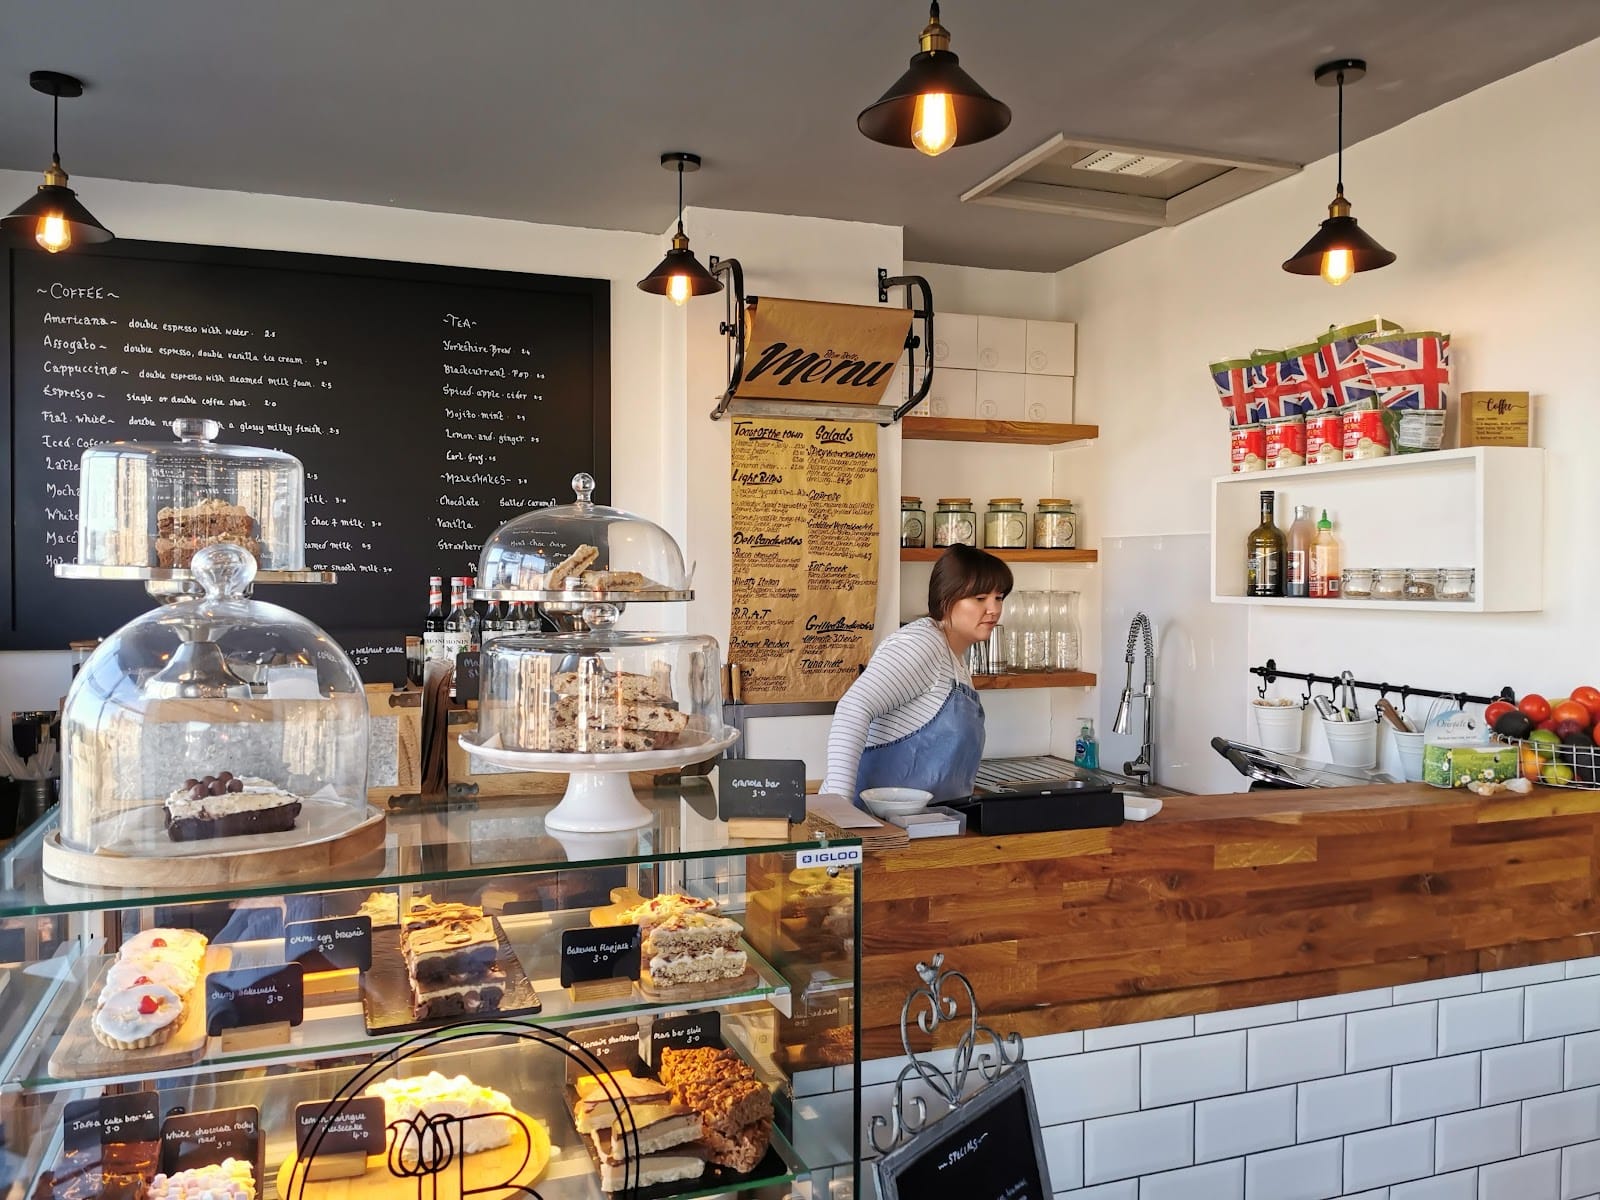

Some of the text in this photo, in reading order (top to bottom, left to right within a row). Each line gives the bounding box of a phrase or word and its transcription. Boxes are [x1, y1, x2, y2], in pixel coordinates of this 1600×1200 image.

[128, 319, 158, 330] double
[162, 324, 198, 334] espresso
[200, 325, 222, 335] with
[124, 343, 153, 354] double
[198, 349, 224, 360] double
[228, 352, 259, 362] vanilla
[263, 352, 275, 362] ice
[442, 340, 512, 358] Yorkshire Brew
[443, 363, 506, 378] Blackcurrant
[138, 369, 167, 380] double
[170, 372, 202, 382] espresso
[206, 374, 225, 383] with
[267, 376, 290, 388] milk
[442, 384, 473, 397] Spiced
[476, 390, 500, 399] apple
[506, 390, 528, 400] cider
[126, 392, 154, 405] single
[170, 394, 197, 405] double
[202, 397, 226, 408] coffee
[1482, 398, 1520, 416] Coffee
[41, 410, 69, 425] Flat
[445, 408, 476, 420] Mojito
[480, 410, 504, 421] mint
[445, 428, 475, 440] Lemon
[478, 431, 494, 442] and
[815, 424, 854, 442] Salads
[41, 434, 70, 448] Iced
[446, 449, 464, 461] Earl
[732, 468, 758, 486] Light
[439, 494, 480, 507] Chocolate
[499, 498, 524, 508] Salted
[436, 517, 474, 530] Vanilla
[437, 538, 482, 551] Strawberr
[313, 563, 328, 571] over
[331, 563, 356, 572] smooth
[386, 646, 404, 654] cake
[801, 659, 824, 668] Tuna
[764, 778, 780, 789] bar
[752, 789, 767, 798] 3.0
[815, 850, 858, 863] IGLOO
[316, 934, 333, 945] egg
[318, 944, 335, 953] 3.0
[592, 954, 609, 964] 3.0
[266, 995, 284, 1004] 3.0
[686, 1035, 700, 1044] 3.0
[103, 1116, 124, 1127] cake
[104, 1126, 120, 1135] 3.0
[194, 1125, 232, 1138] chocolate
